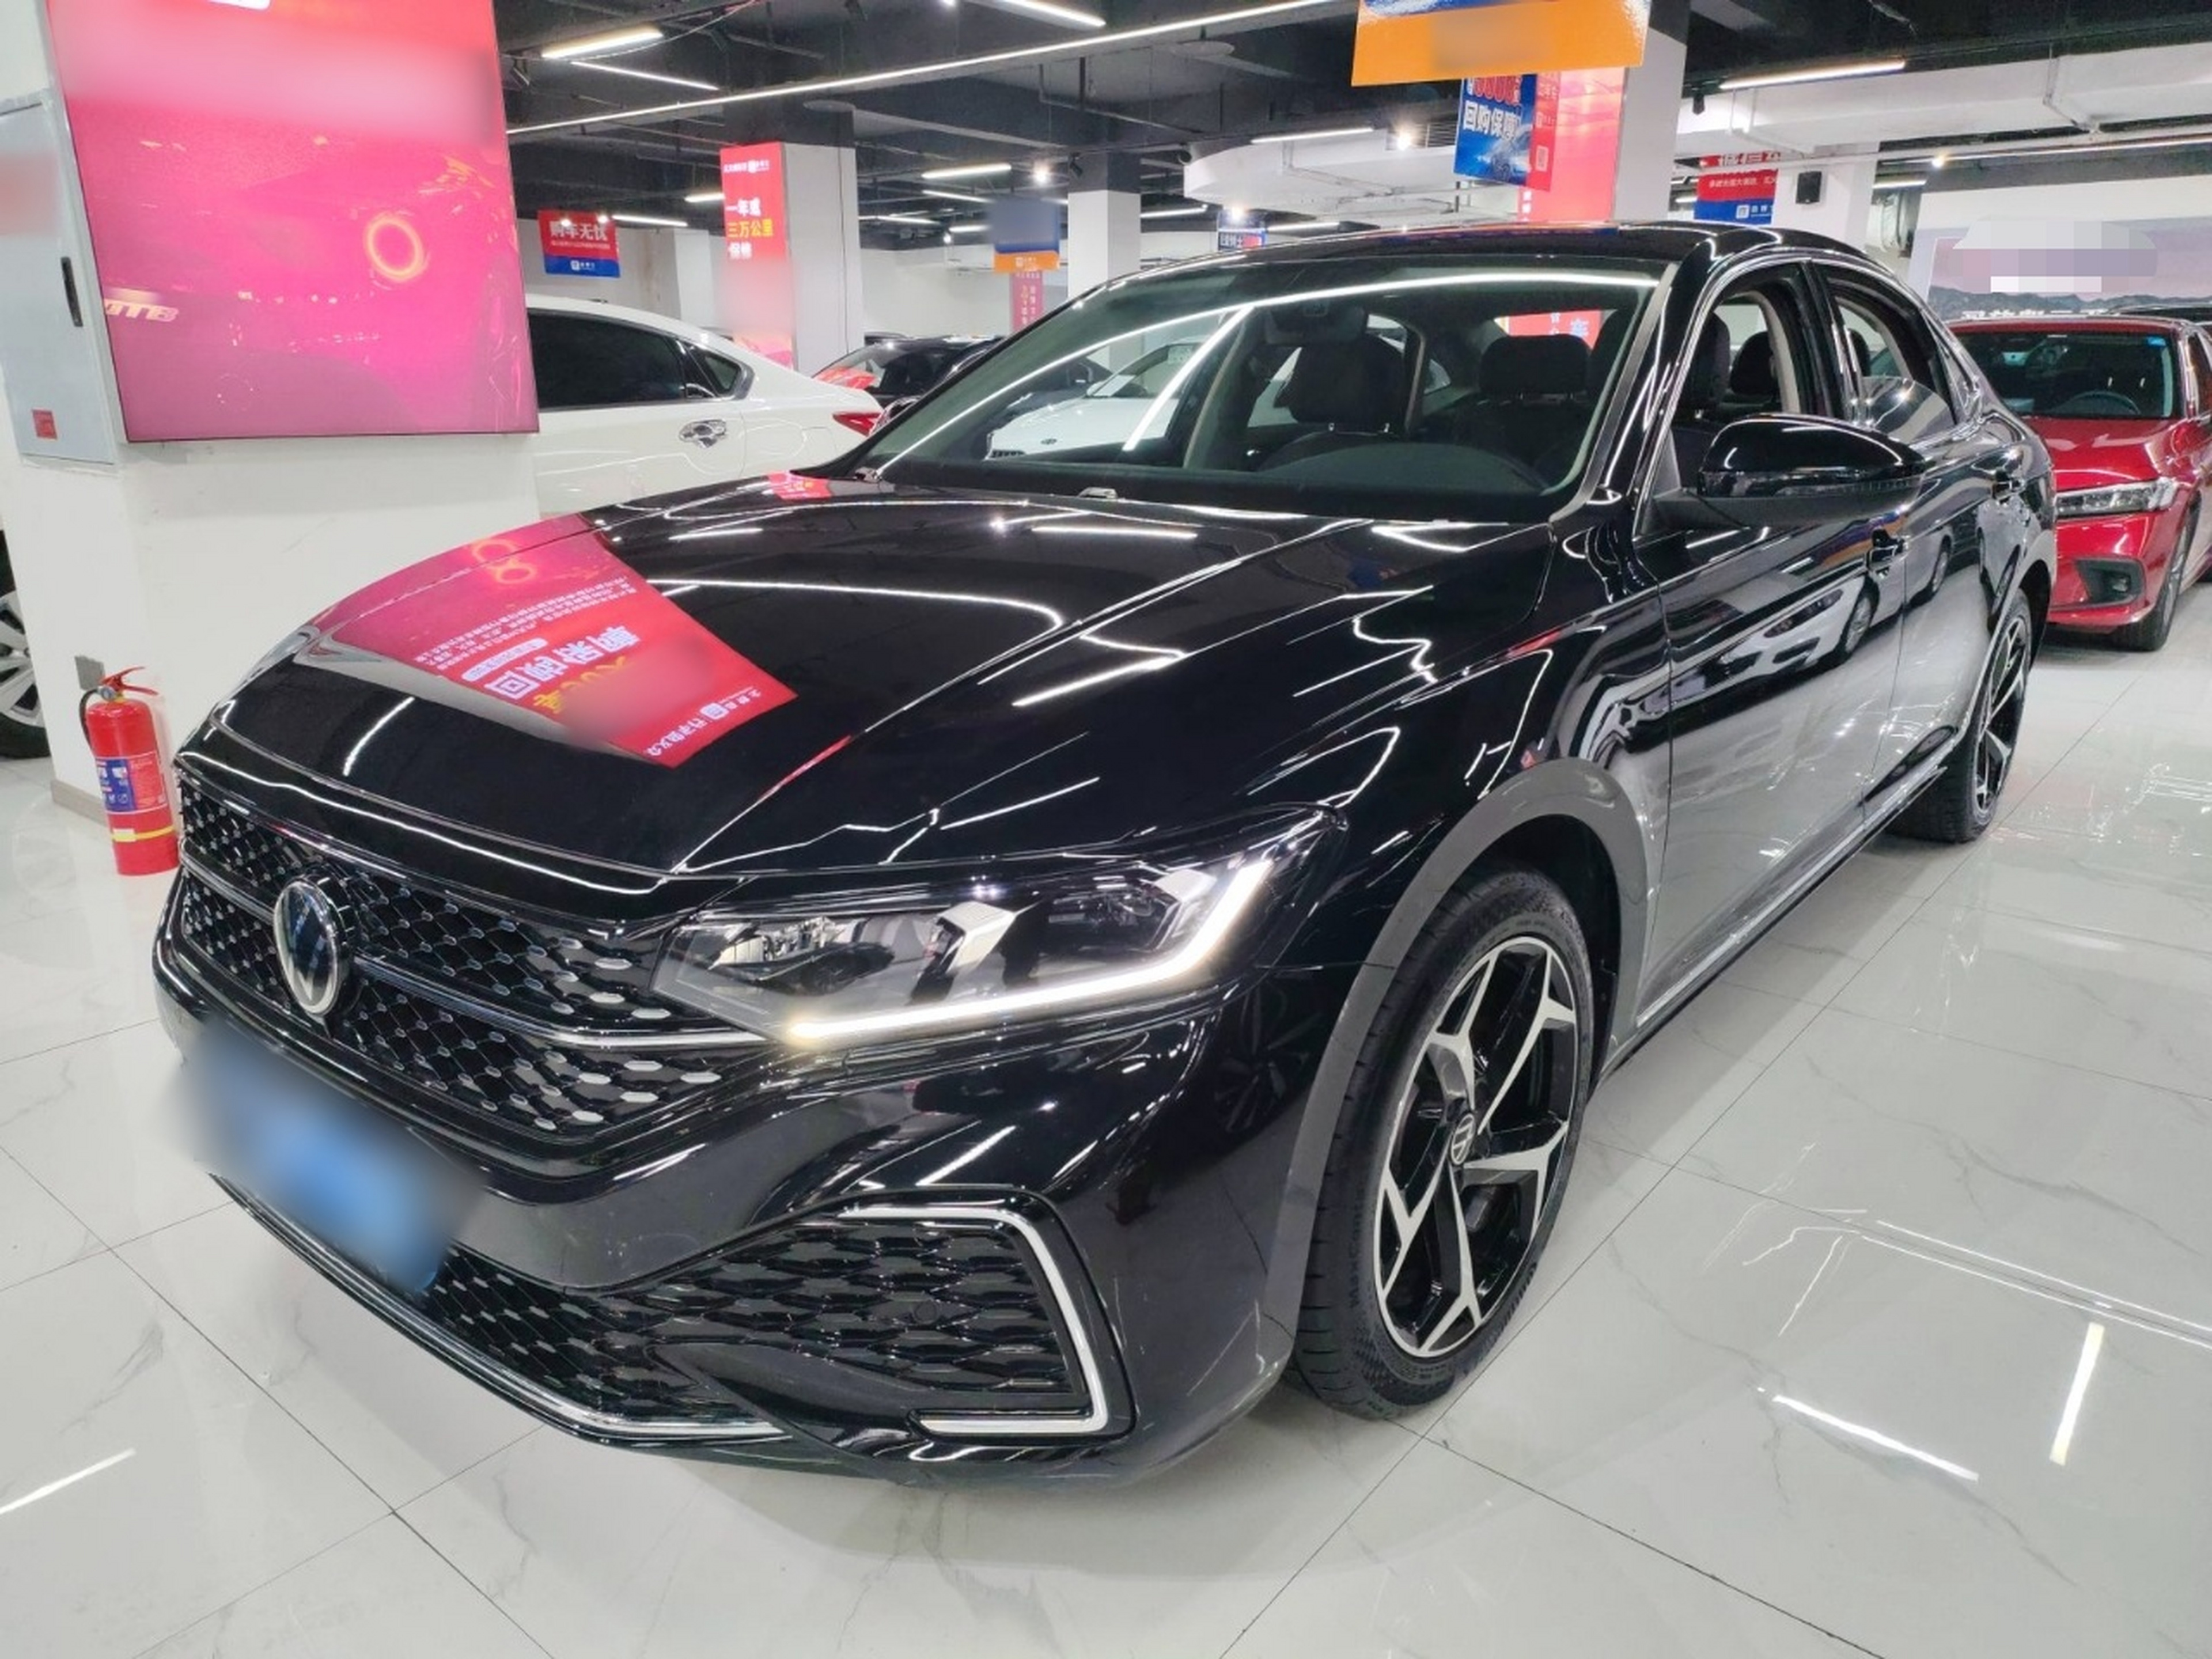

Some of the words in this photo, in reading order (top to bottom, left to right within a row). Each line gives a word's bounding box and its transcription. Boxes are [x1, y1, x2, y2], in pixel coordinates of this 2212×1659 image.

[1463, 99, 1522, 142] 回购保障
[727, 218, 774, 238] 三万公里
